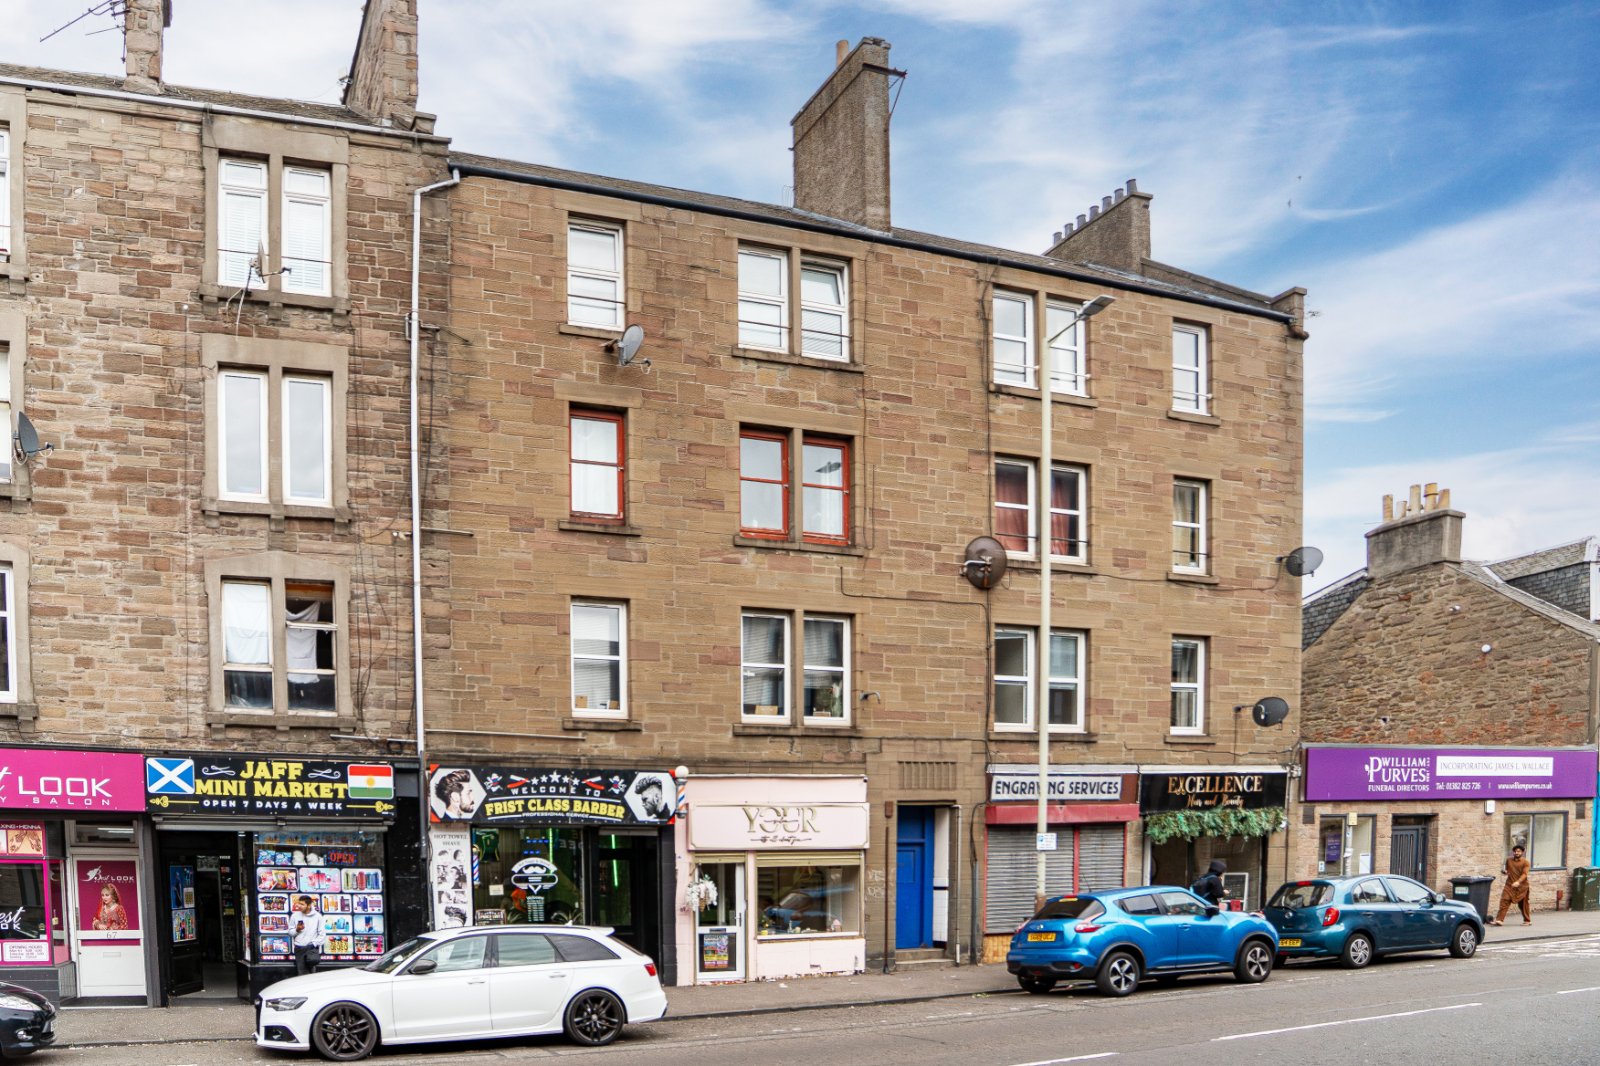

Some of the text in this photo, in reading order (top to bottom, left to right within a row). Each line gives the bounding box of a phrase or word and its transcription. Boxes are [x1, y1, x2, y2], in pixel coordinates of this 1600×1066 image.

[1382, 757, 1426, 767] WILLIAM
[1440, 762, 1494, 770] INCORPORATING
[1495, 763, 1514, 771] JAMES
[1522, 763, 1550, 771] WALLACE
[240, 760, 303, 779] JAFF
[1368, 756, 1427, 783] PURVES
[18, 776, 112, 797] LOOK
[194, 779, 349, 799] MINI MARKET
[510, 786, 600, 797] WELCOME TO
[995, 781, 1119, 795] ENGRAVNG SERVICES
[1167, 775, 1263, 795] EXCELLENCE
[1368, 784, 1395, 792] FUNERAL
[33, 797, 110, 805] SALON
[203, 799, 236, 808] OPEN
[256, 801, 288, 809] DAYS
[294, 802, 301, 810] A
[308, 803, 342, 811] WEEK
[485, 800, 626, 818] FRIST CLASS BARBER
[741, 807, 821, 833] YOUR
[330, 852, 354, 863] OPEN
[106, 931, 118, 939] 67
